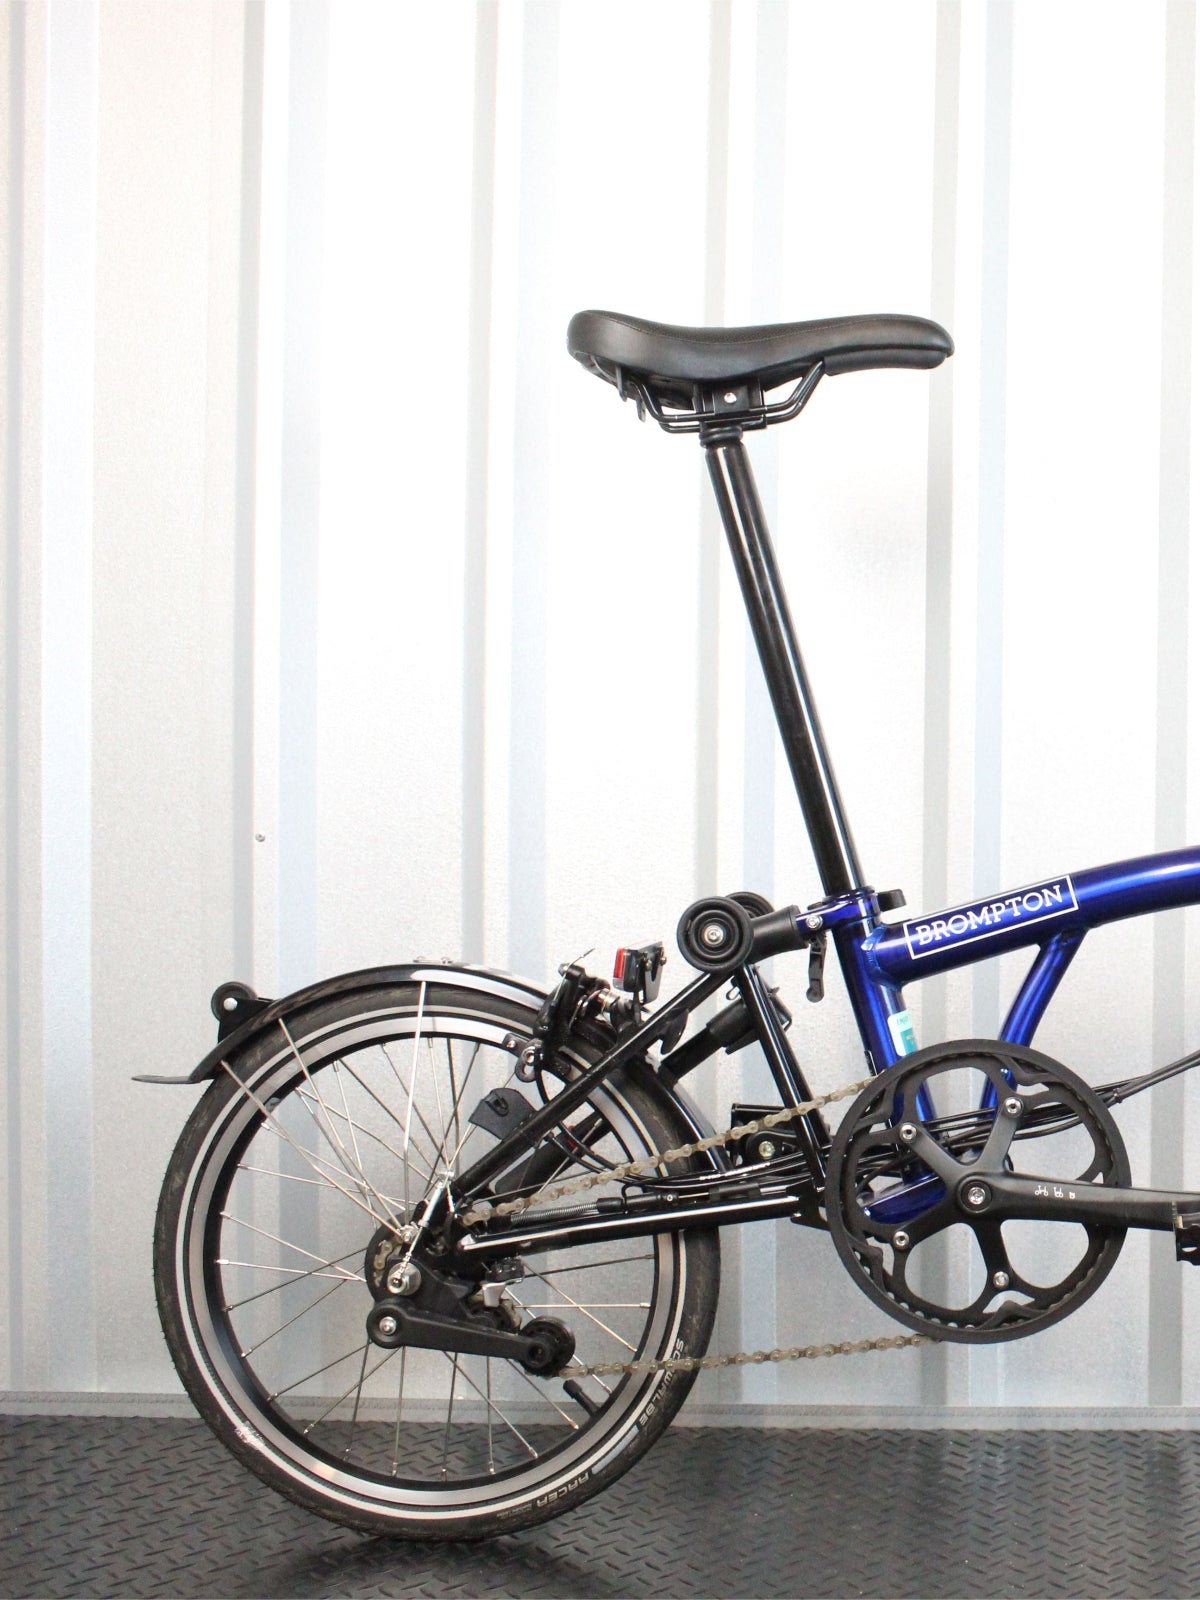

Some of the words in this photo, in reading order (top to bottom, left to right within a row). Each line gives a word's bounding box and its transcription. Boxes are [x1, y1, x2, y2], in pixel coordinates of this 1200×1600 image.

[915, 884, 1061, 946] BROMPTON
[639, 1338, 684, 1426] SCWALBE
[536, 1472, 589, 1507] RACER
